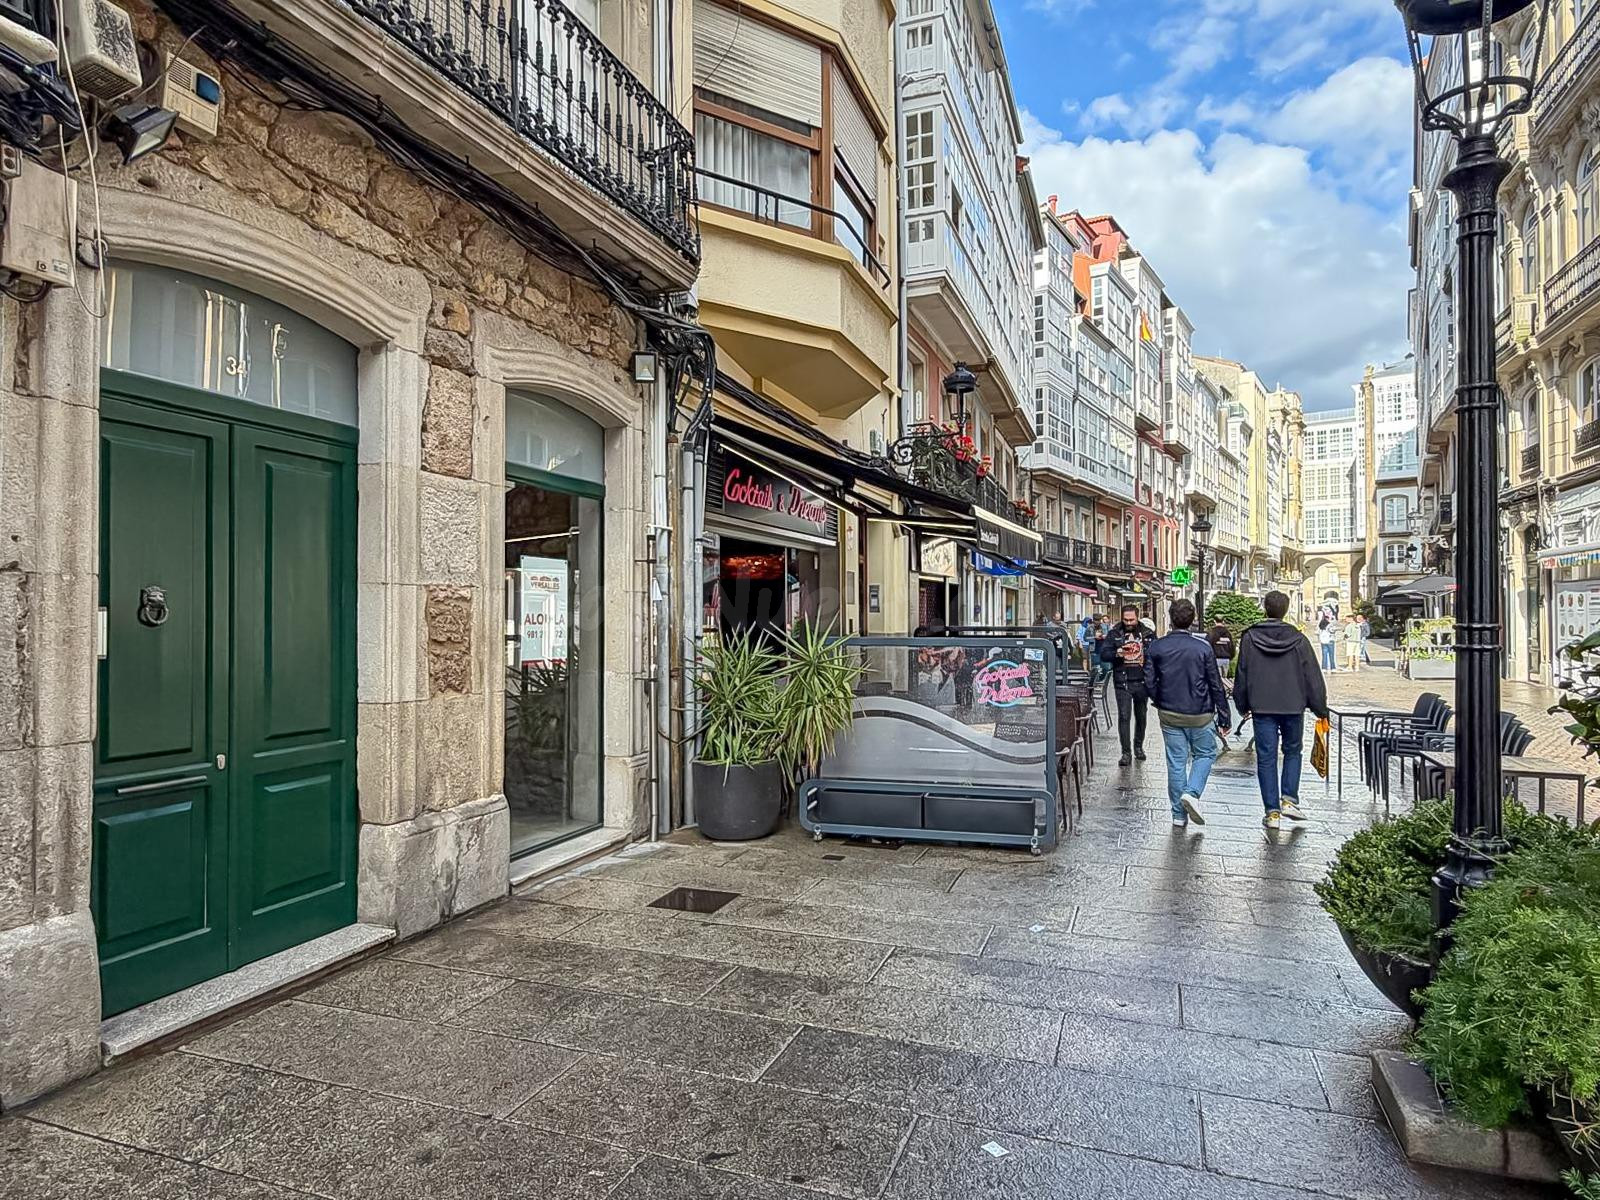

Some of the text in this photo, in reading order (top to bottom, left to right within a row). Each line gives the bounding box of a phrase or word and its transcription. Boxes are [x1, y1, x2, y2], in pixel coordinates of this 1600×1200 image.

[226, 356, 247, 378] 34
[724, 468, 774, 511] Cocktails
[789, 484, 828, 524] Dreams
